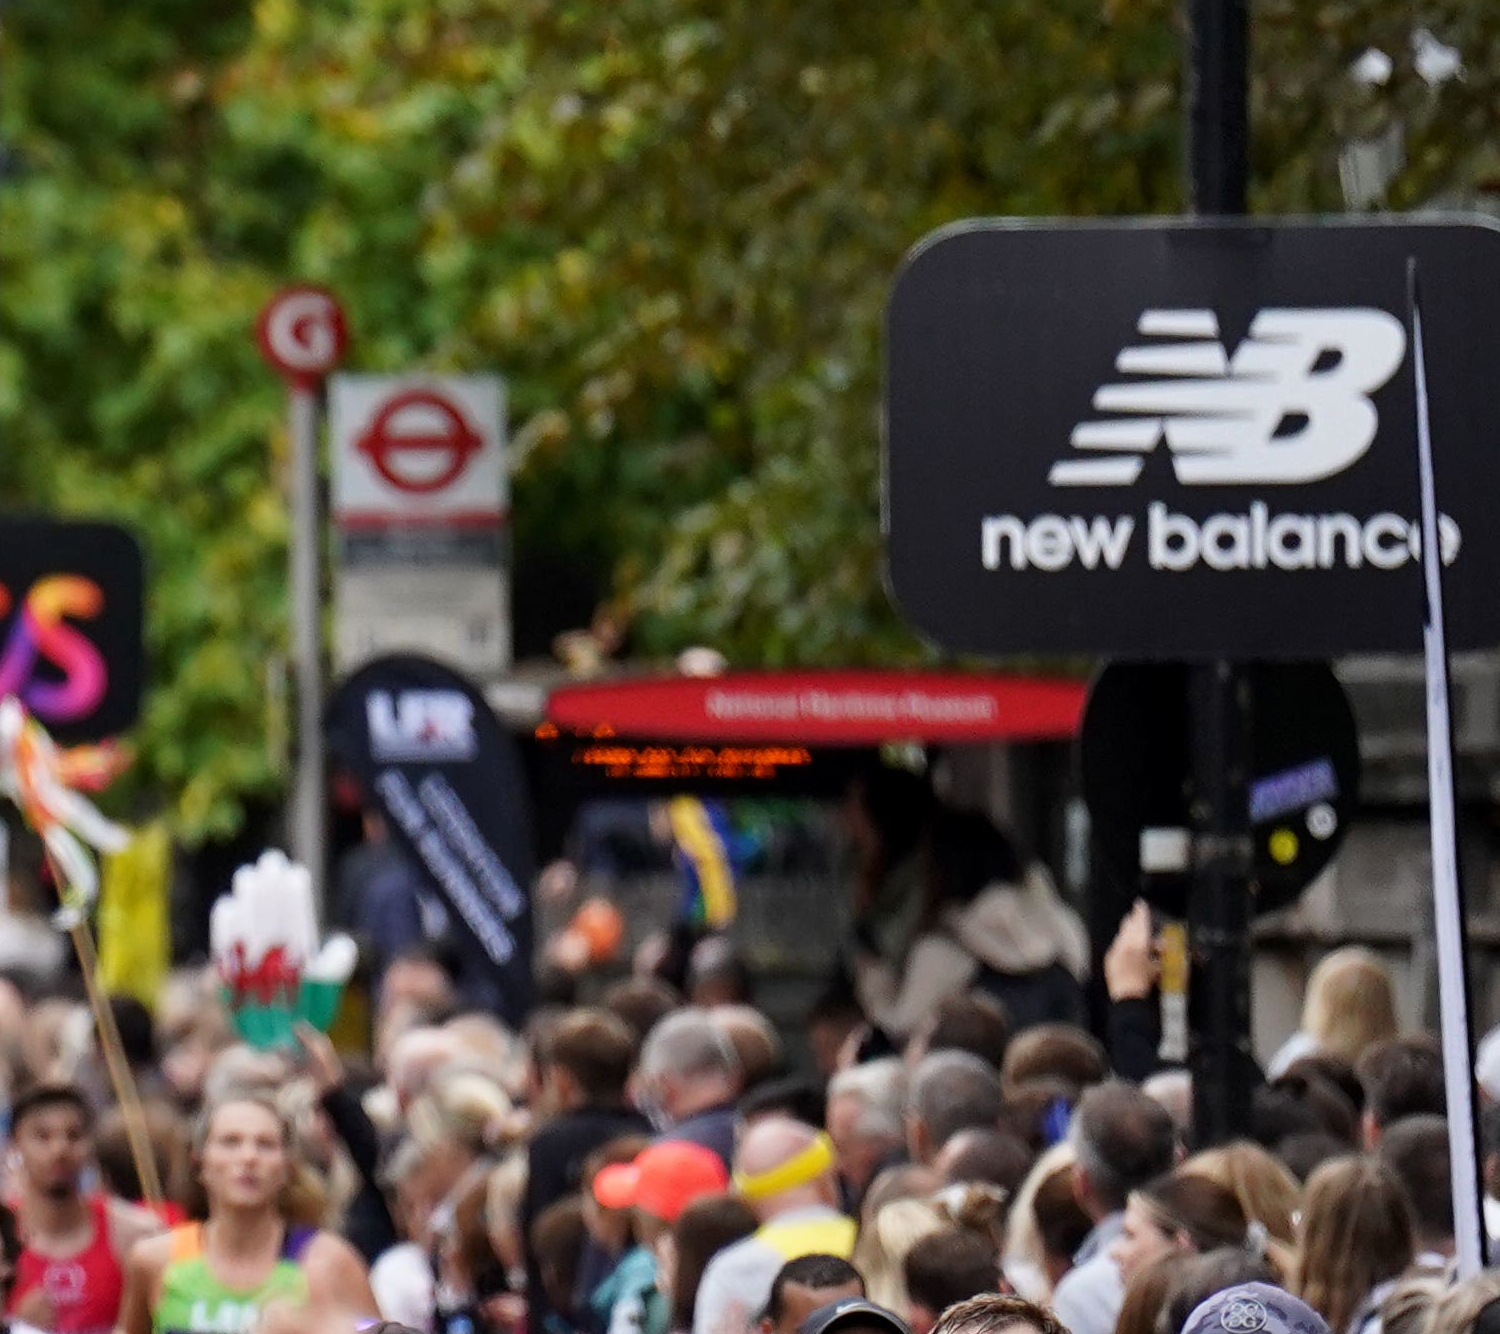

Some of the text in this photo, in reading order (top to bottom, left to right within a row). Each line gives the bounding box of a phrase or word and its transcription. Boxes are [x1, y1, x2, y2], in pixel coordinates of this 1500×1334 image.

[268, 289, 337, 364] G
[1049, 307, 1407, 486] NB
[981, 515, 1134, 571] new
